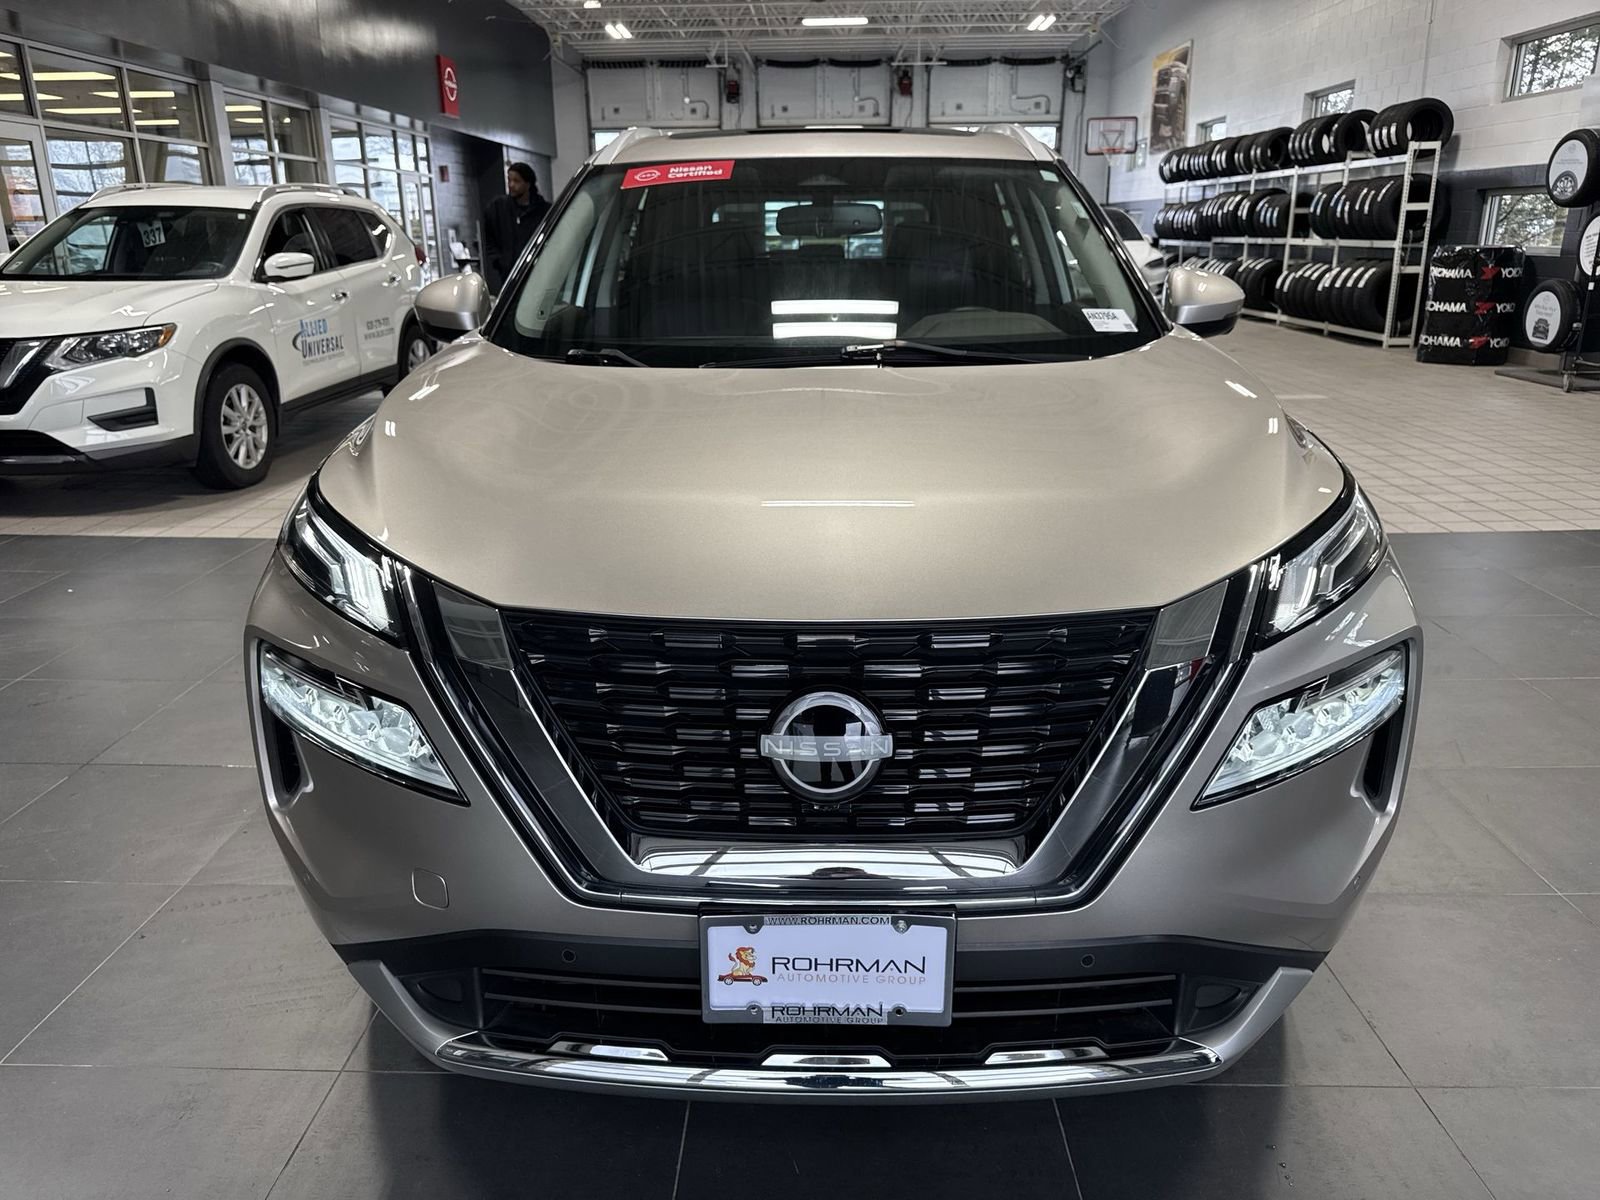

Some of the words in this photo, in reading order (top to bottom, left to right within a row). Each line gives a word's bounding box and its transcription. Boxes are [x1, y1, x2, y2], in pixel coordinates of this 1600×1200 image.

[667, 169, 723, 178] Certified
[669, 165, 712, 173] Nissan
[143, 227, 162, 245] 337
[300, 319, 328, 338] ALLIED
[301, 335, 345, 359] UNIVERSAL
[764, 738, 889, 757] NISSAN
[767, 916, 890, 925] WWW.ROHRMAN.COM
[772, 956, 926, 974] ROHRMAN
[777, 973, 869, 984] AUTOMOTIVE
[876, 975, 926, 985] GROUP
[771, 1003, 883, 1018] ROHRMAN
[775, 1016, 842, 1024] AUTOMOTIVE
